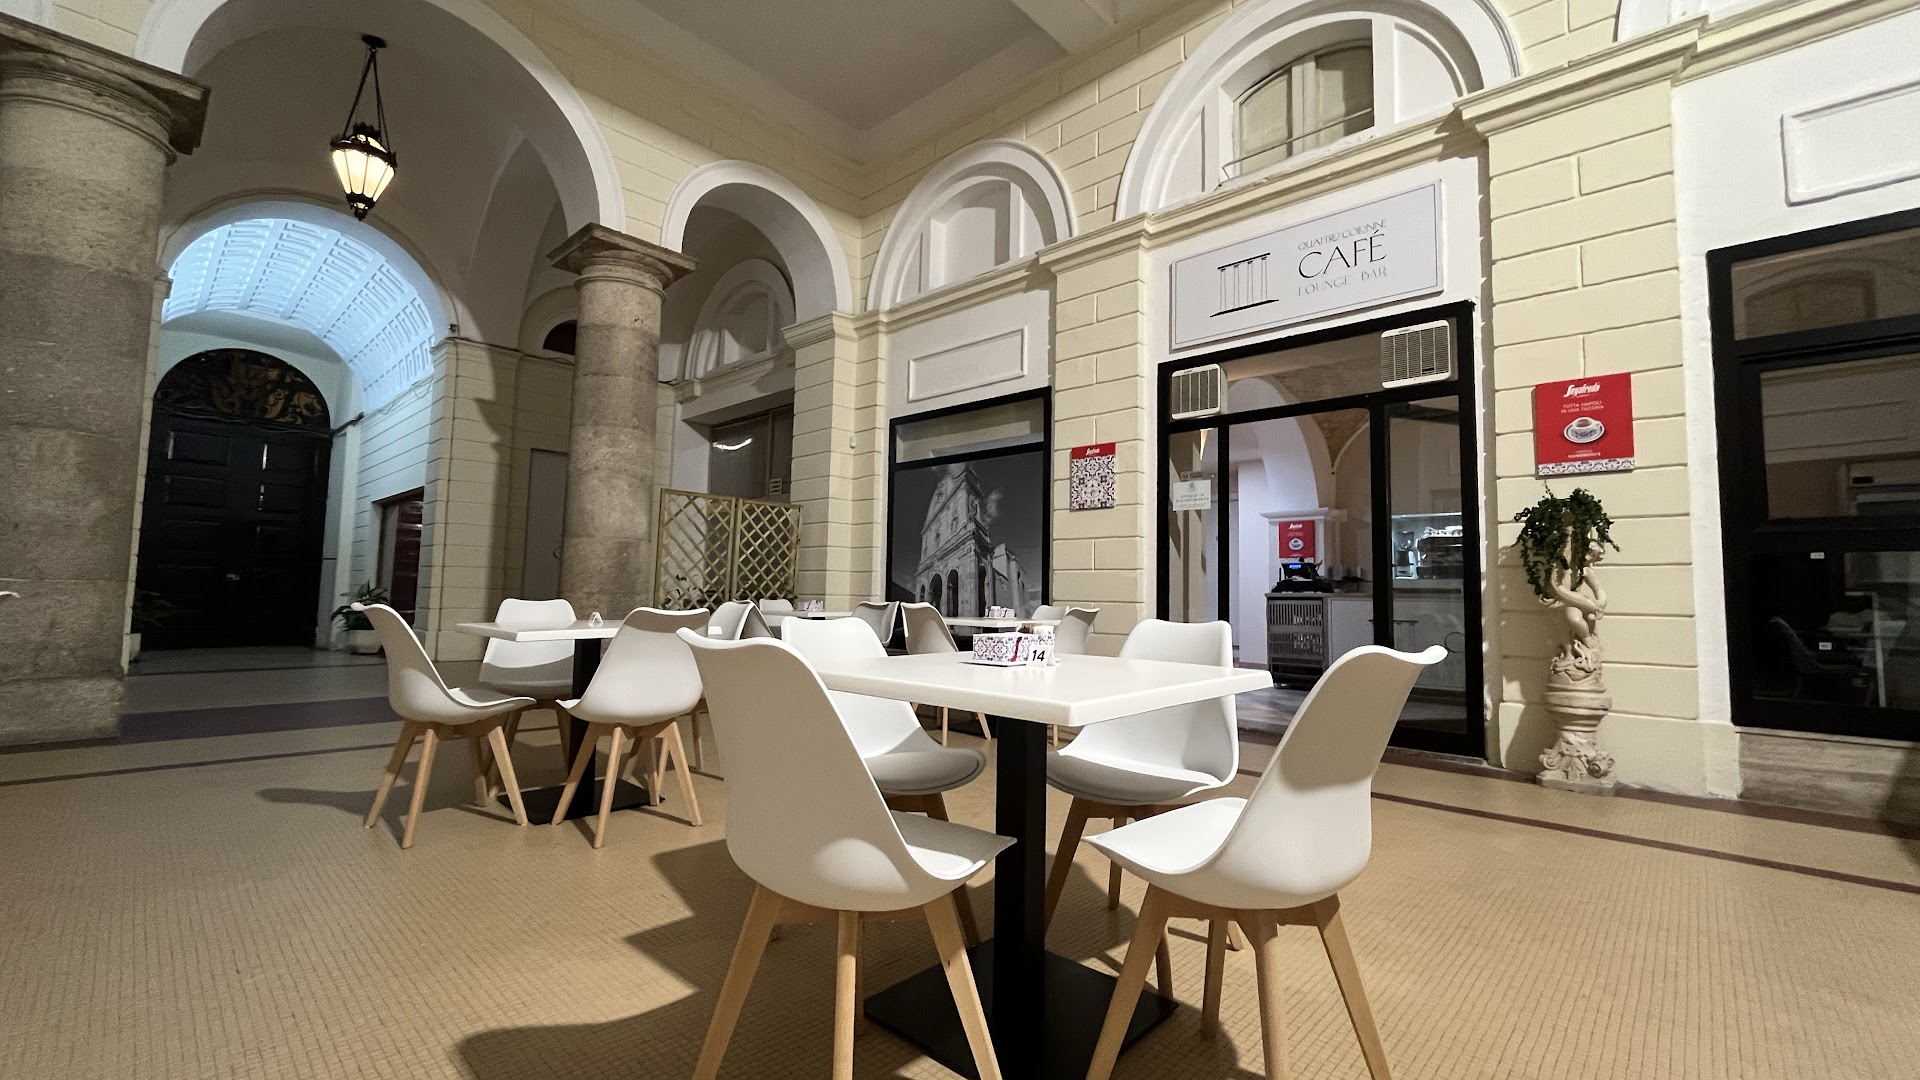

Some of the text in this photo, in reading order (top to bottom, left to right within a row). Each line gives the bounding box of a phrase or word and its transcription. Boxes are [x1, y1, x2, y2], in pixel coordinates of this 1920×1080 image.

[1297, 219, 1386, 250] QUATTRO COLONNE
[1298, 229, 1388, 279] CAFÉ
[1298, 266, 1388, 297] LOUNGE BAR
[1032, 649, 1045, 661] 14
